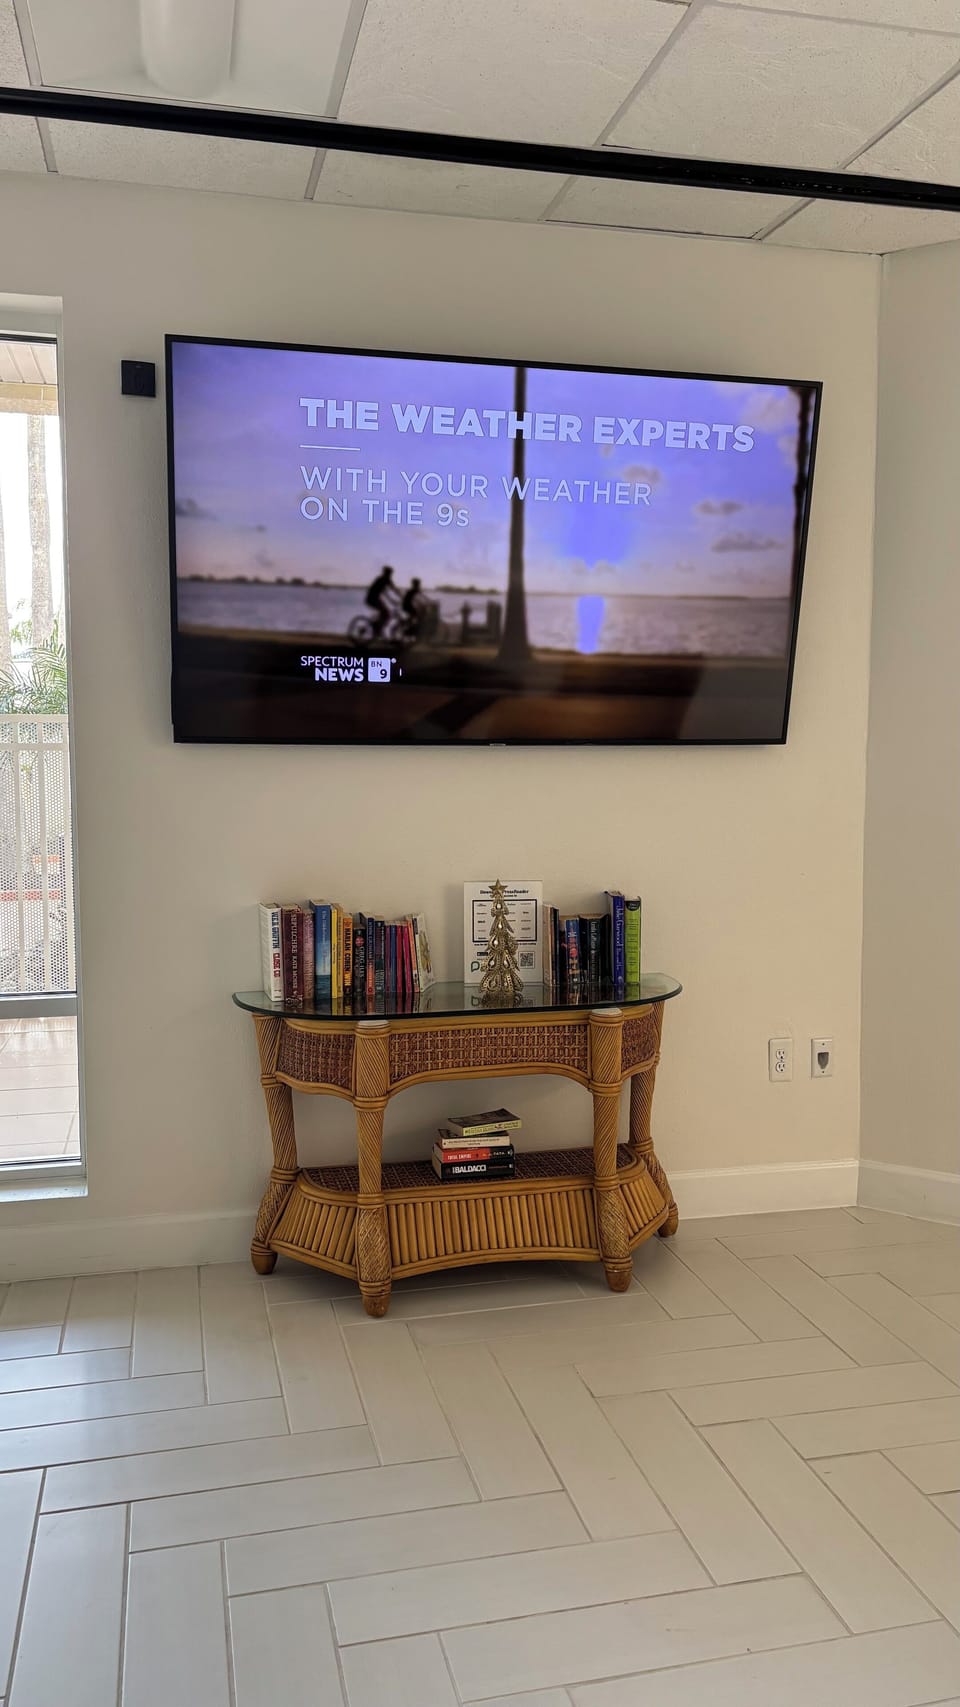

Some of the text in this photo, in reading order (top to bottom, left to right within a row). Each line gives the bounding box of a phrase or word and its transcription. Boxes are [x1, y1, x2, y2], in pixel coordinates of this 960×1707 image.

[300, 398, 755, 453] THE WEATHER EXPERTS
[300, 465, 651, 505] WITH YOUR WEATHER
[300, 496, 469, 527] ON THE 9s
[300, 655, 364, 667] SPECTRUM
[314, 668, 364, 682] NEWS
[379, 668, 388, 679] 9
[615, 920, 624, 948] Garwood
[455, 1164, 487, 1174] BALDACCI
